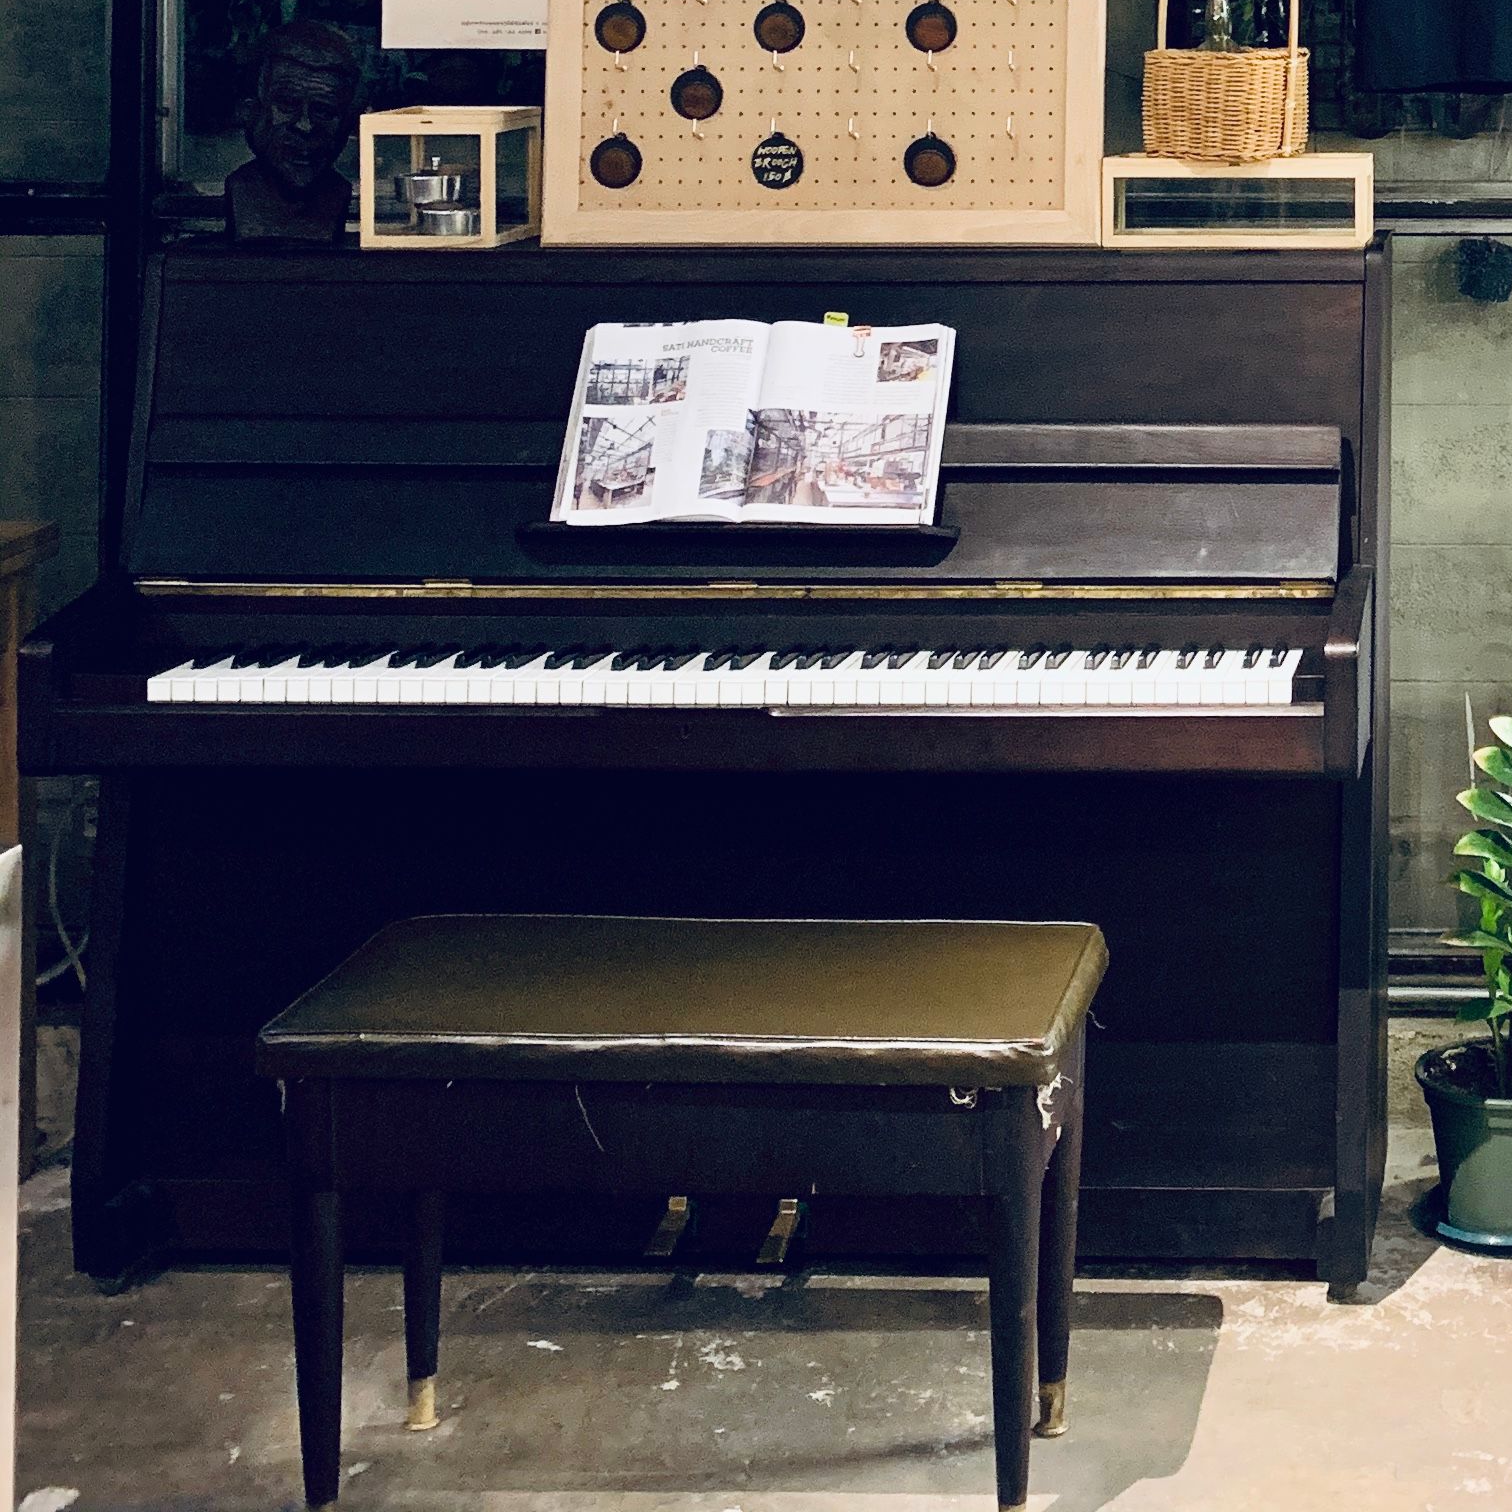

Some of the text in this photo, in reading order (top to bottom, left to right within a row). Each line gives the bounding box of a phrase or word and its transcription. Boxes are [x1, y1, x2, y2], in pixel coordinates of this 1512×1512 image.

[754, 157, 798, 169] BROOCH
[763, 172, 782, 181] 150
[662, 337, 754, 352] SATI HANDCRAFT
